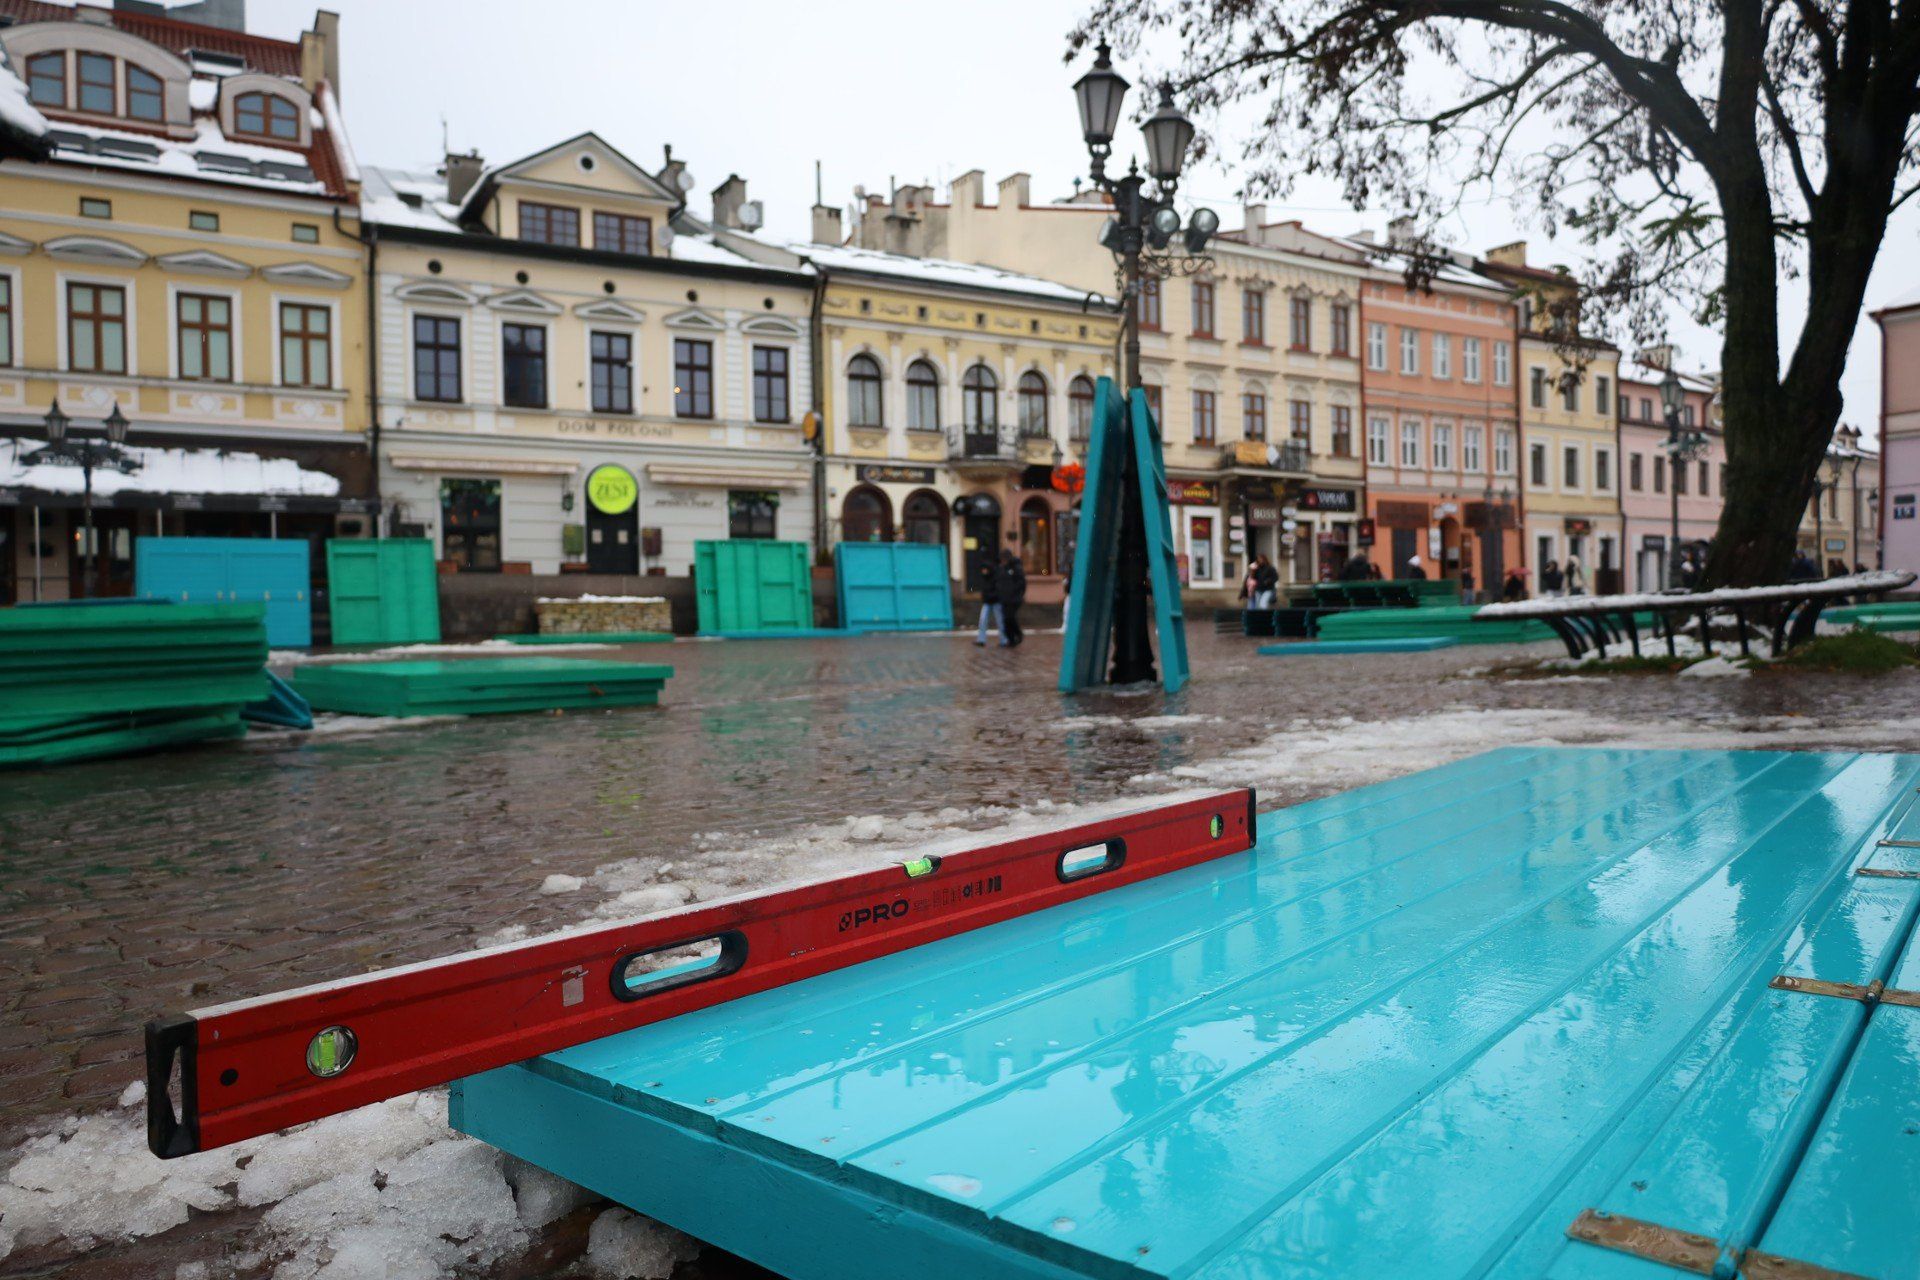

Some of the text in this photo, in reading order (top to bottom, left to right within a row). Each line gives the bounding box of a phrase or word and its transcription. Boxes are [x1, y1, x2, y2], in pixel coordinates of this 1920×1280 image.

[558, 420, 596, 433] DOM
[1252, 507, 1278, 520] BOSS
[854, 899, 910, 928] PRO
